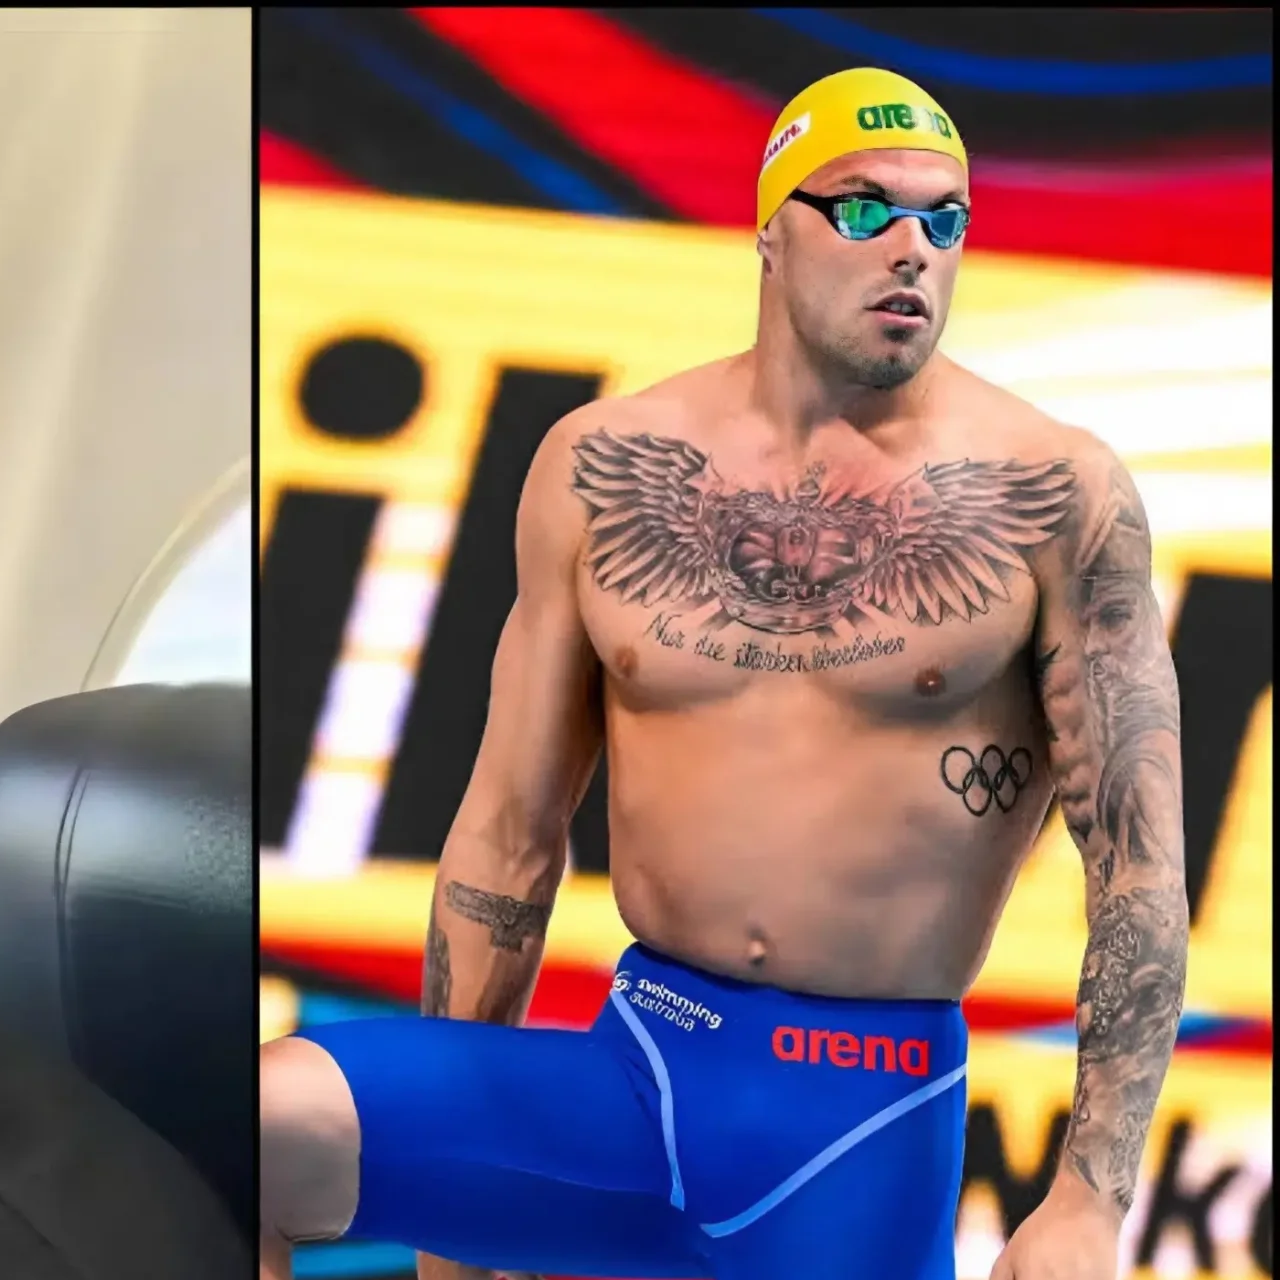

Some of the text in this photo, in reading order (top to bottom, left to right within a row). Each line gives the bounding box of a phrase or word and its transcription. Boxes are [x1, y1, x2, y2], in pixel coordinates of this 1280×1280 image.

[856, 103, 953, 140] area
[643, 611, 687, 650] Nur
[772, 1025, 928, 1077] arena
